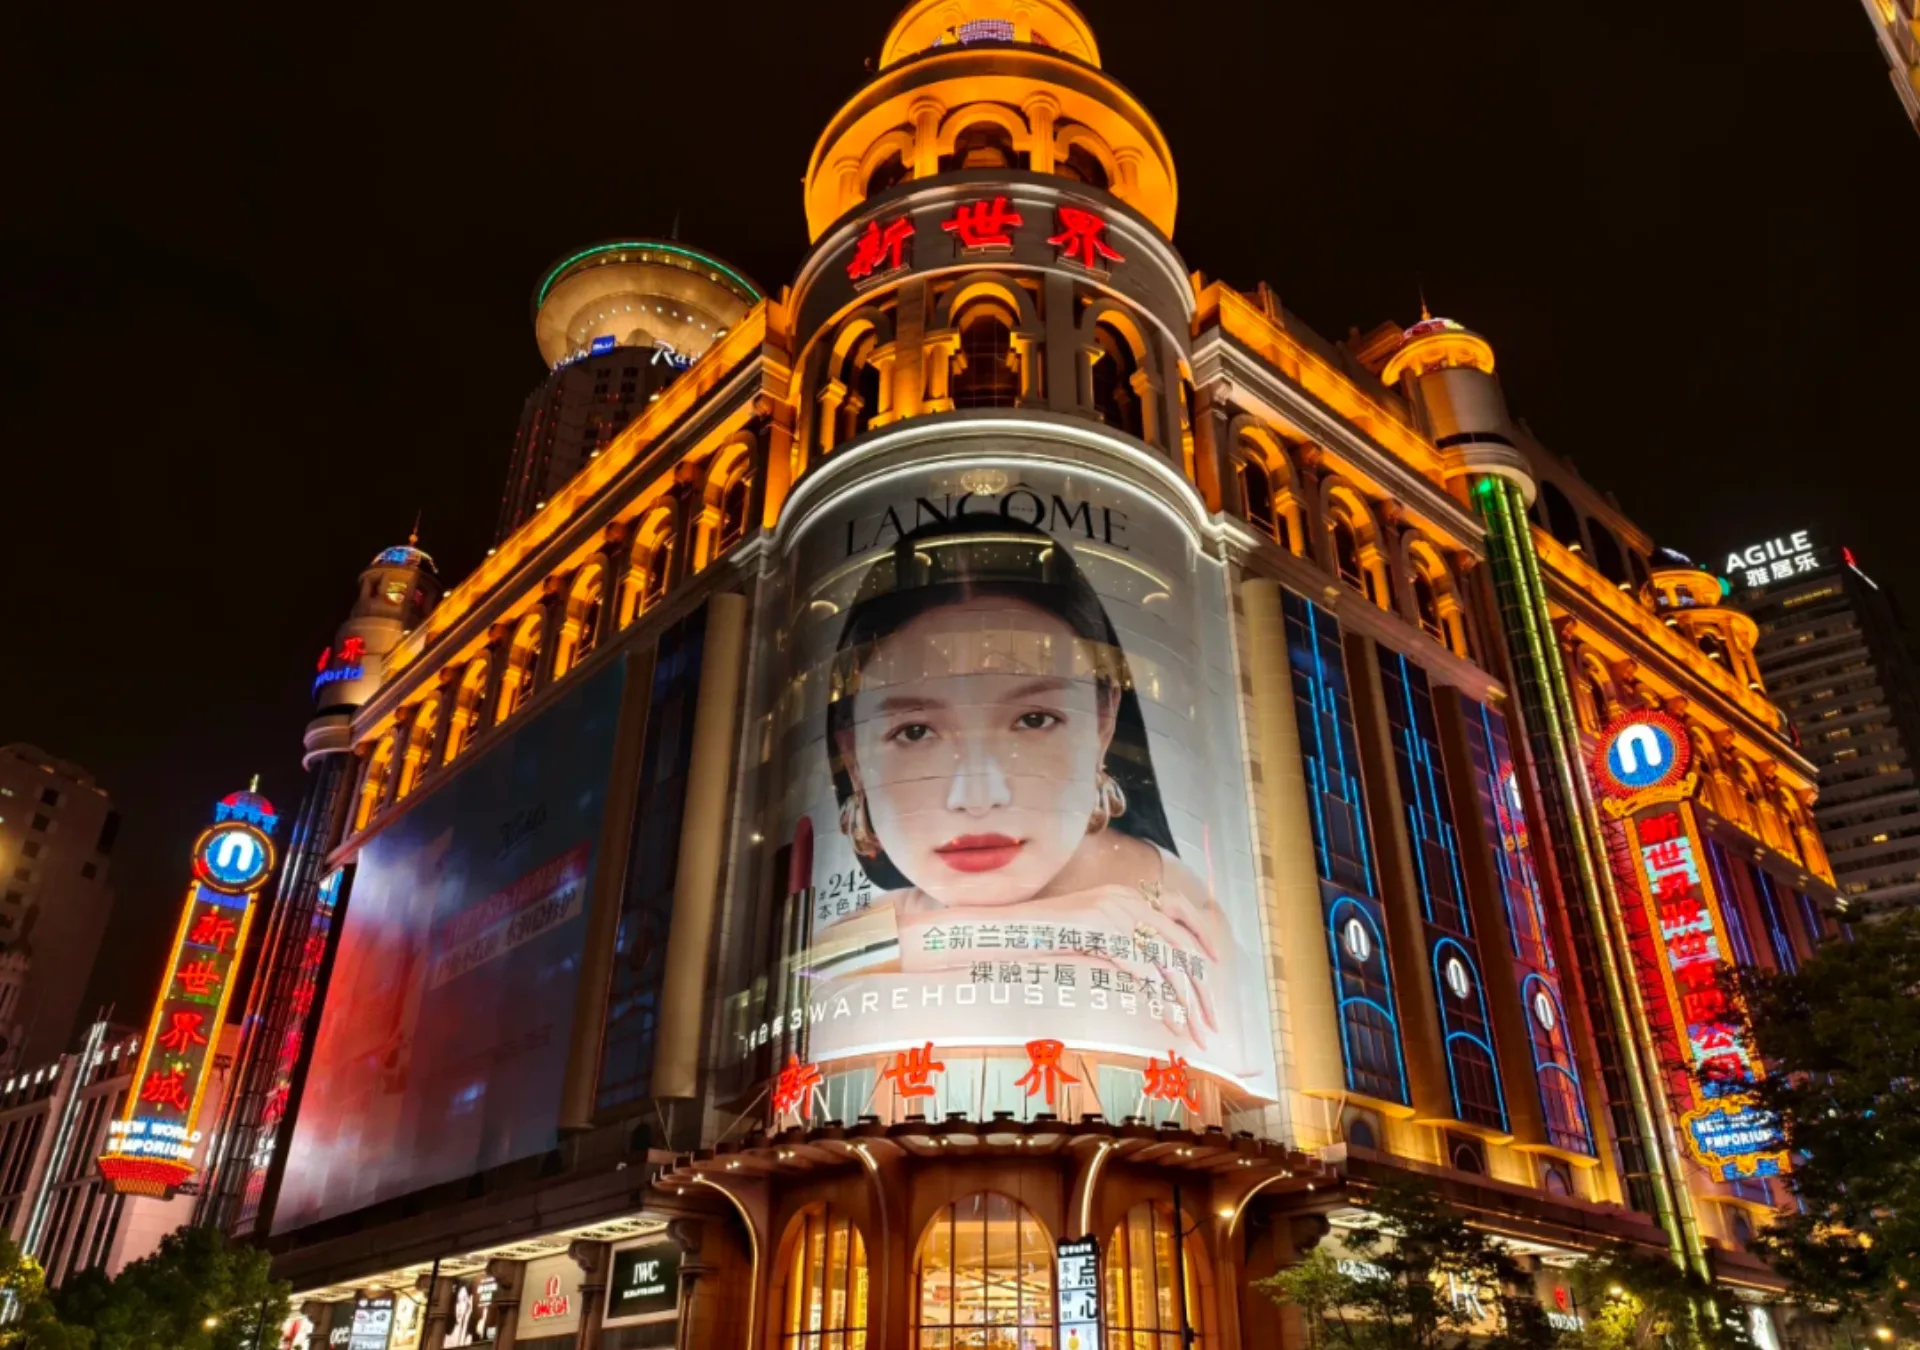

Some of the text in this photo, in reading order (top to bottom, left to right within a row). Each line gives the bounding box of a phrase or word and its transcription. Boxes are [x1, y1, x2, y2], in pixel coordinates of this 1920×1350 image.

[847, 196, 1126, 279] 新世界
[1726, 530, 1813, 574] AGILE
[1745, 551, 1820, 587] 雅居乐
[969, 960, 1077, 987] 裸融于唇
[142, 908, 236, 1112] 新世界城
[773, 1038, 1200, 1119] 新世界城
[107, 1138, 195, 1160] EMPORIUM
[109, 1120, 202, 1143] NEW WORLD
[633, 1260, 660, 1285] IWC
